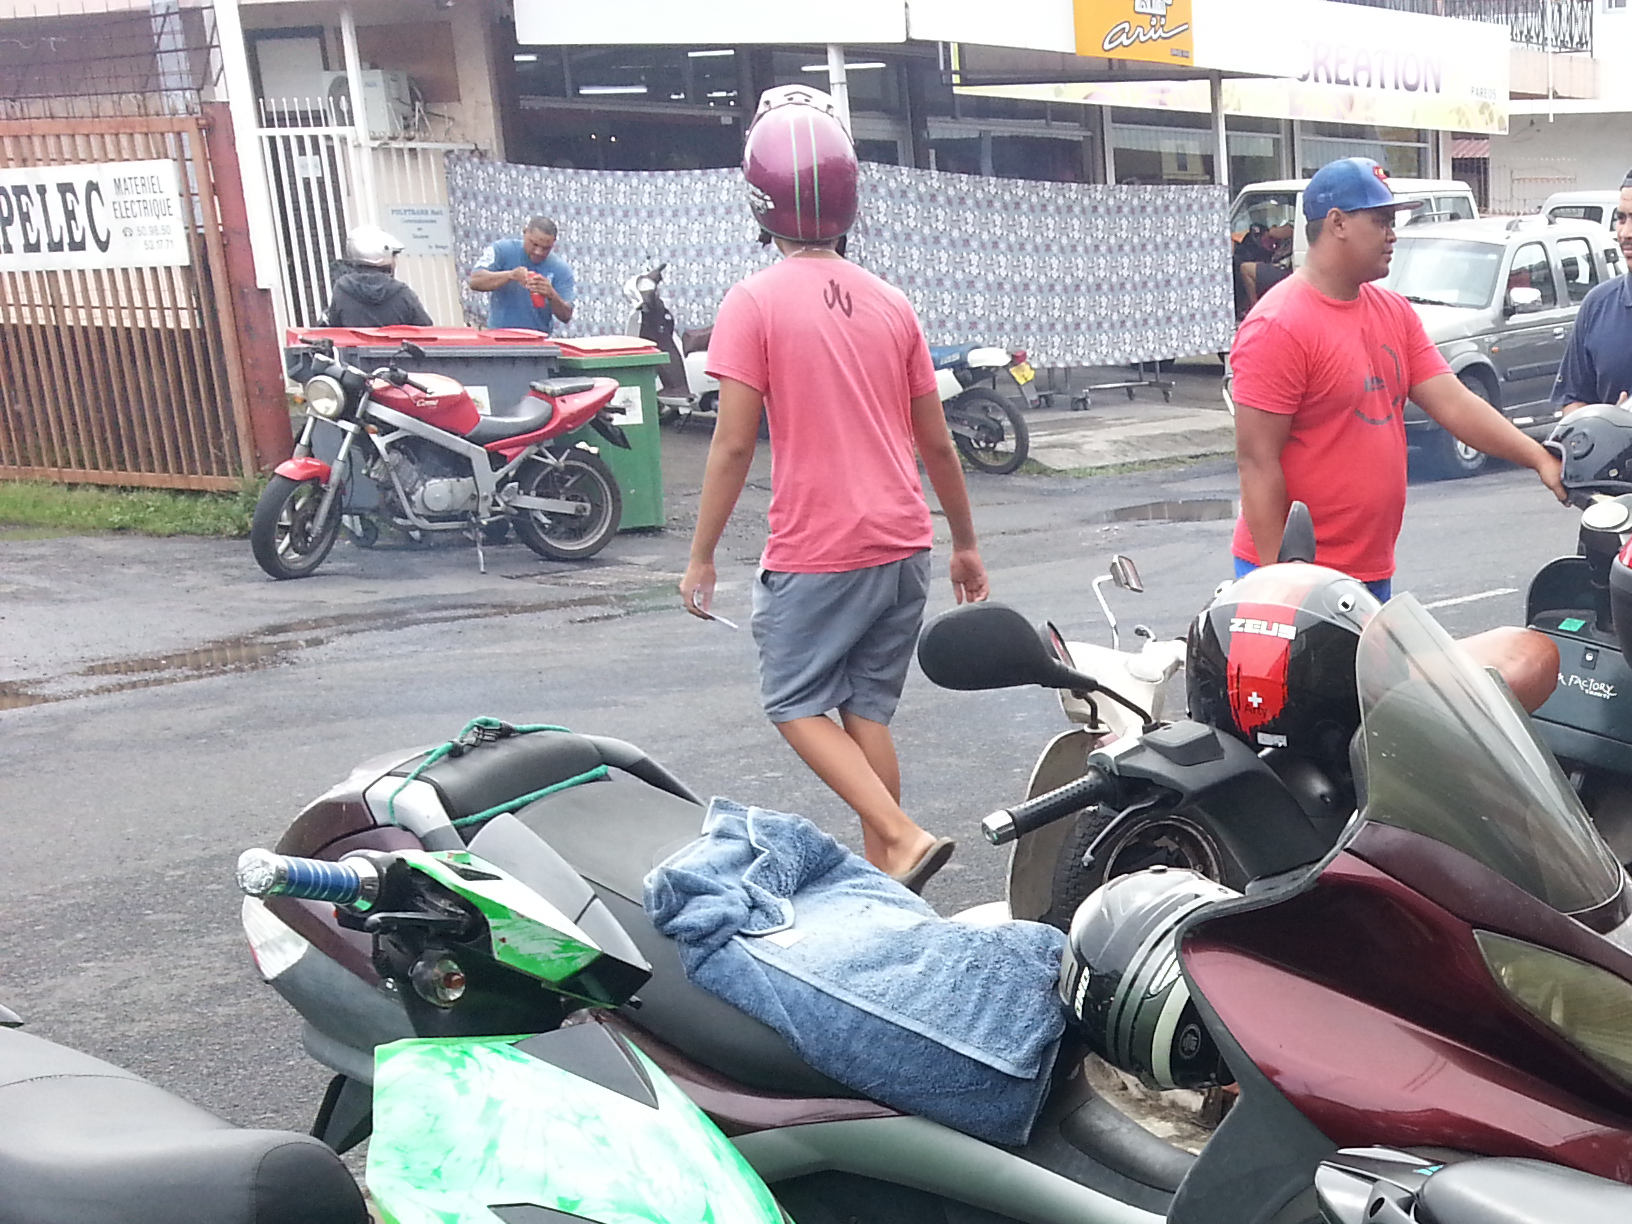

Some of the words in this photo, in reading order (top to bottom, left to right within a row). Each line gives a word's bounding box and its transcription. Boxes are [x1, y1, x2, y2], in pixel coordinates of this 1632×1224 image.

[113, 175, 164, 195] MATERIEL
[112, 198, 174, 221] ELECTRIQUE
[1229, 617, 1297, 641] ZEUS
[1568, 673, 1618, 697] FACTORY
